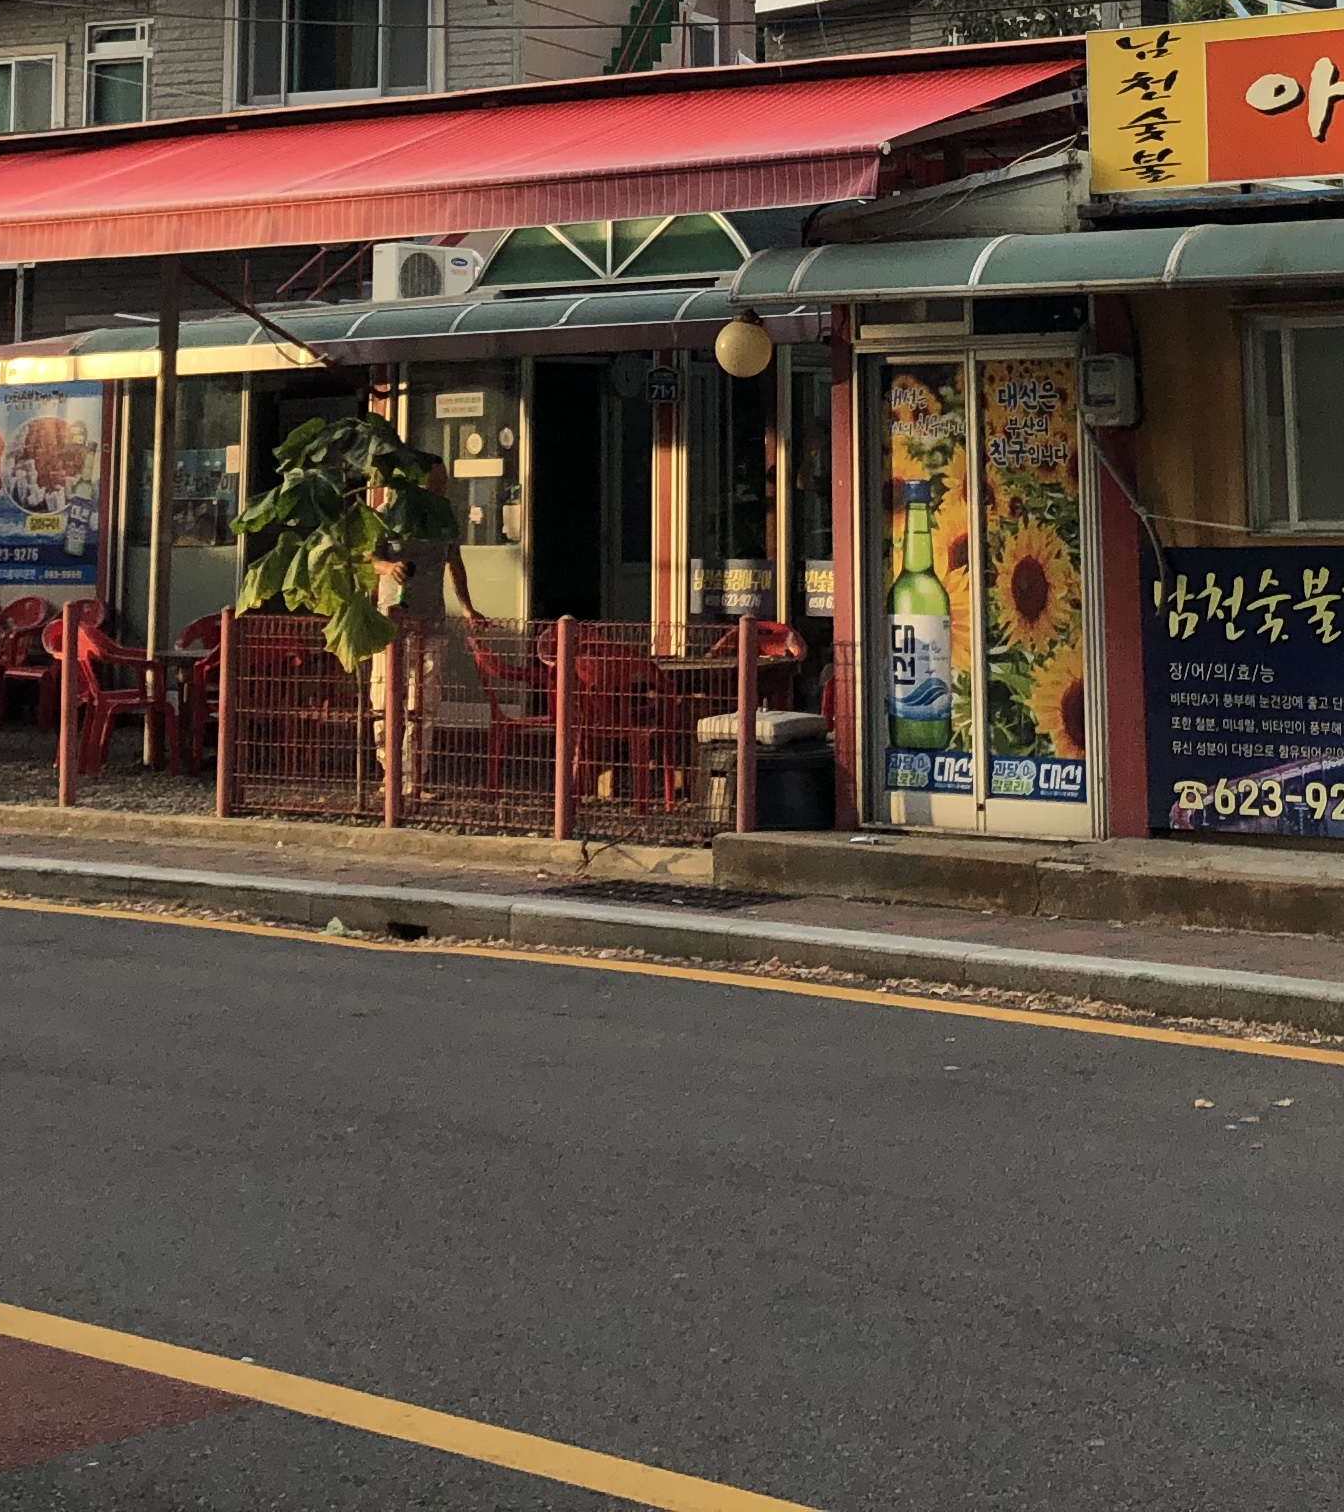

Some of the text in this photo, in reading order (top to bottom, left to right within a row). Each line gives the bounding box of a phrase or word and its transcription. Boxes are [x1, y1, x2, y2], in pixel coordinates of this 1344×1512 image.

[997, 379, 1061, 413] 대선은
[1006, 415, 1050, 438] 부산의
[989, 438, 1069, 468] 친구입니다
[1168, 661, 1275, 683] 장/어/의/효/능
[1170, 692, 1219, 708] 비타민A가
[1222, 693, 1256, 708] 풍부해
[1258, 694, 1304, 710] 눈건강에
[1307, 696, 1329, 711] 좋고
[1171, 716, 1192, 731] 또한
[1262, 719, 1306, 735] 비타민이
[1309, 720, 1342, 736] 풍부해
[1171, 740, 1193, 755] 뮤신
[1196, 741, 1228, 756] 성분이
[1231, 743, 1275, 758] 다량으로
[1278, 744, 1322, 760] 함유되어
[1039, 763, 1082, 791] 대선
